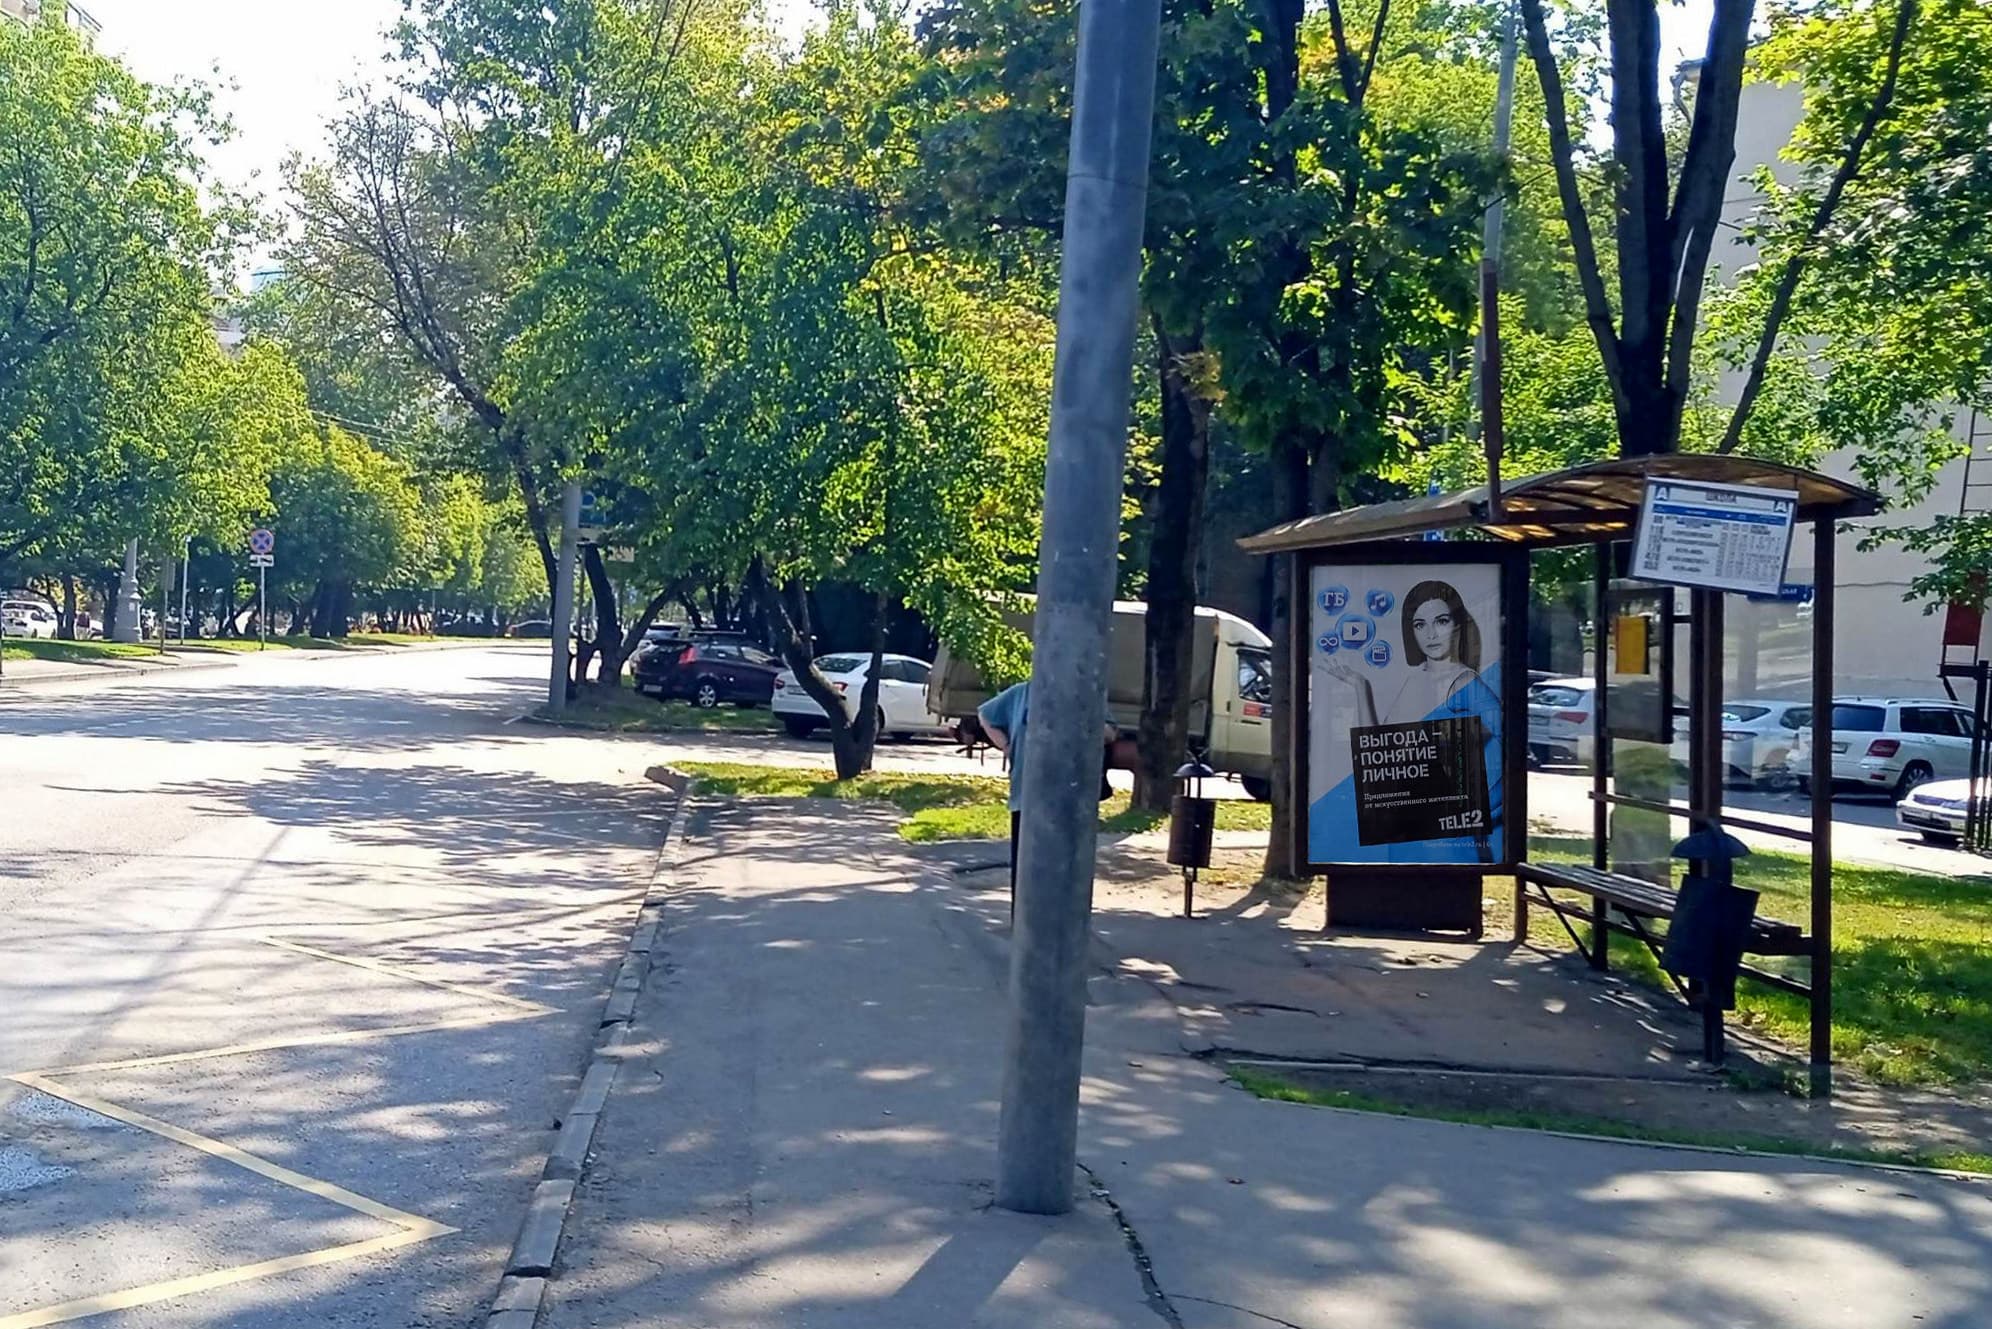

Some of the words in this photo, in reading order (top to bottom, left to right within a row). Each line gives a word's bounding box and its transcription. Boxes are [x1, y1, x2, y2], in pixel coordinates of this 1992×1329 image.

[1323, 591, 1345, 607] ГБ
[1359, 729, 1430, 748] ВЫГОДА
[1360, 746, 1438, 766] ПОНЯТИЕ
[1362, 763, 1430, 783] ЛИЧНОЕ
[1438, 809, 1484, 831] TELE2
